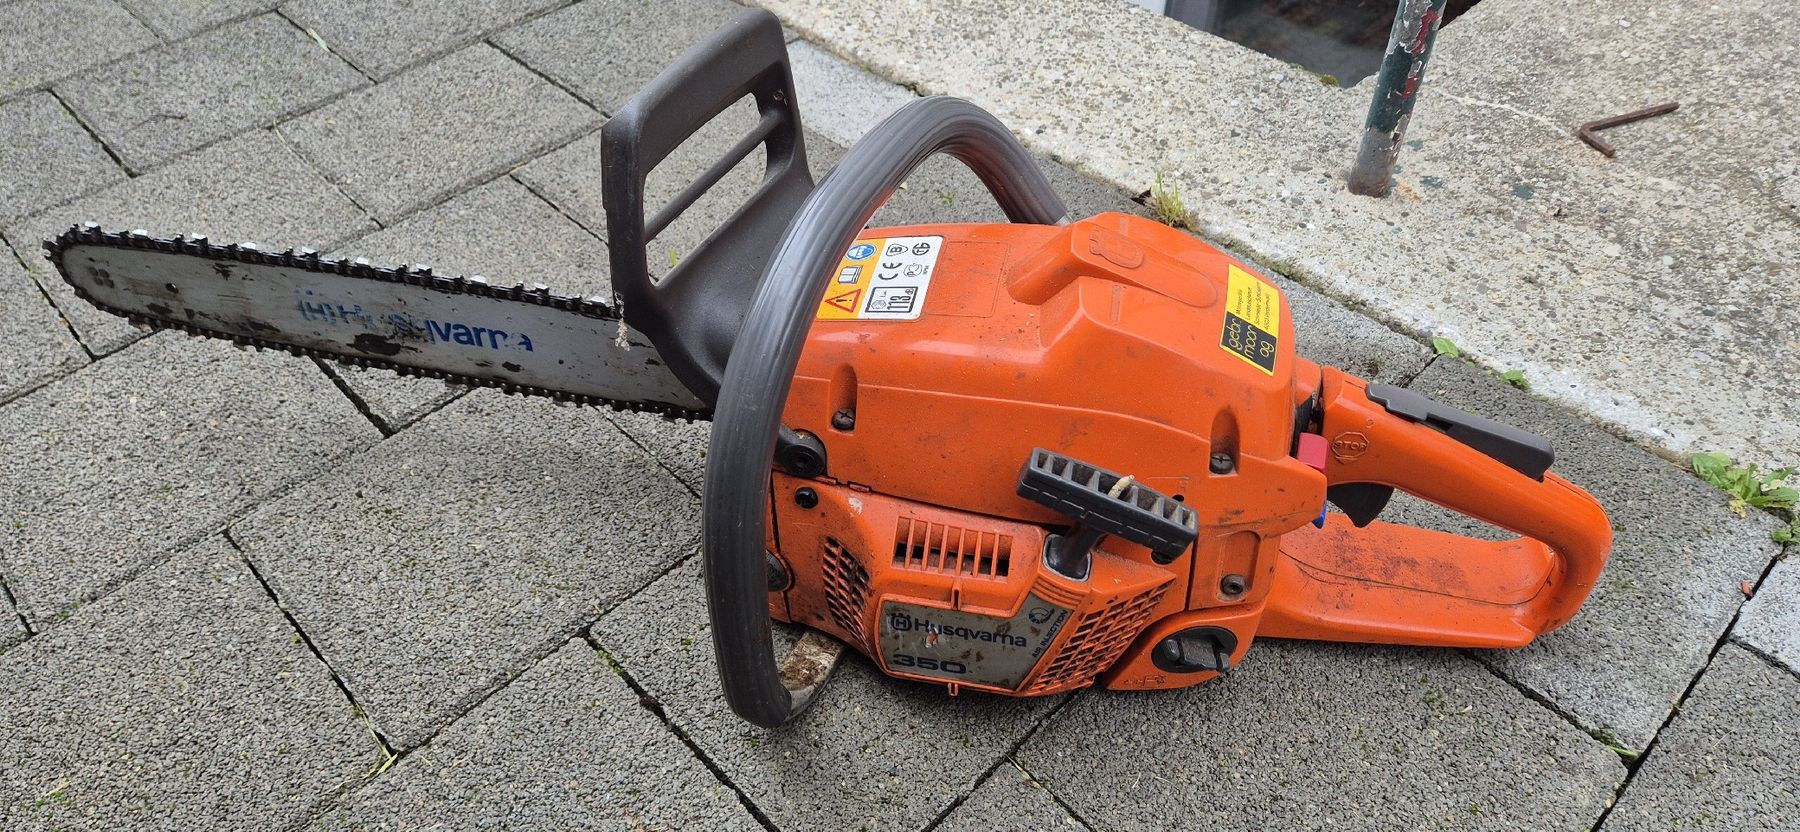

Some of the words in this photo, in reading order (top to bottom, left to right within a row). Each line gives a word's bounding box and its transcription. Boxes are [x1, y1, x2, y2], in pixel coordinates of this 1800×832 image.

[887, 295, 911, 310] 113
[914, 618, 1027, 647] Husqvarna
[893, 653, 967, 675] 350
